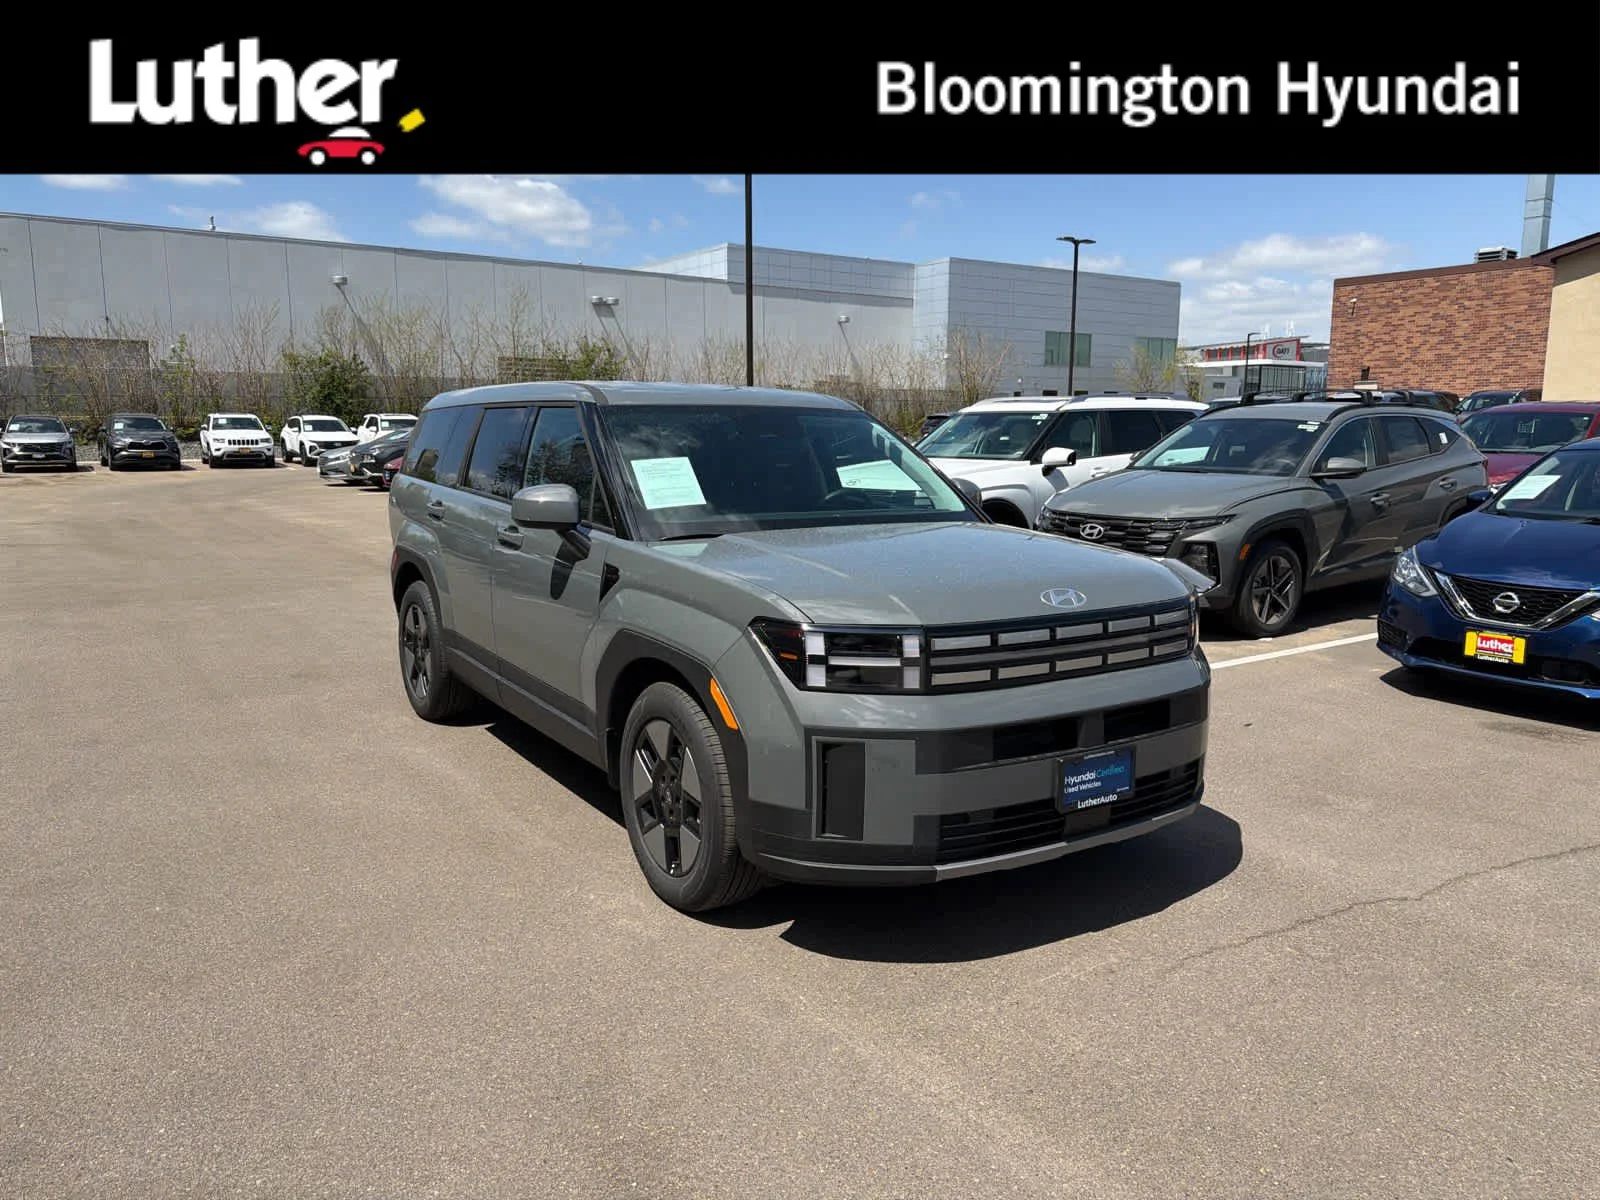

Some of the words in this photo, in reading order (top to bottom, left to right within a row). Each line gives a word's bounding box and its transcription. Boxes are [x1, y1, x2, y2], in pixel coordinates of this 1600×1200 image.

[1477, 637, 1514, 653] Luther
[1064, 785, 1079, 794] Used
[1079, 780, 1102, 791] Vehicles
[1077, 793, 1118, 809] LutherAuto
